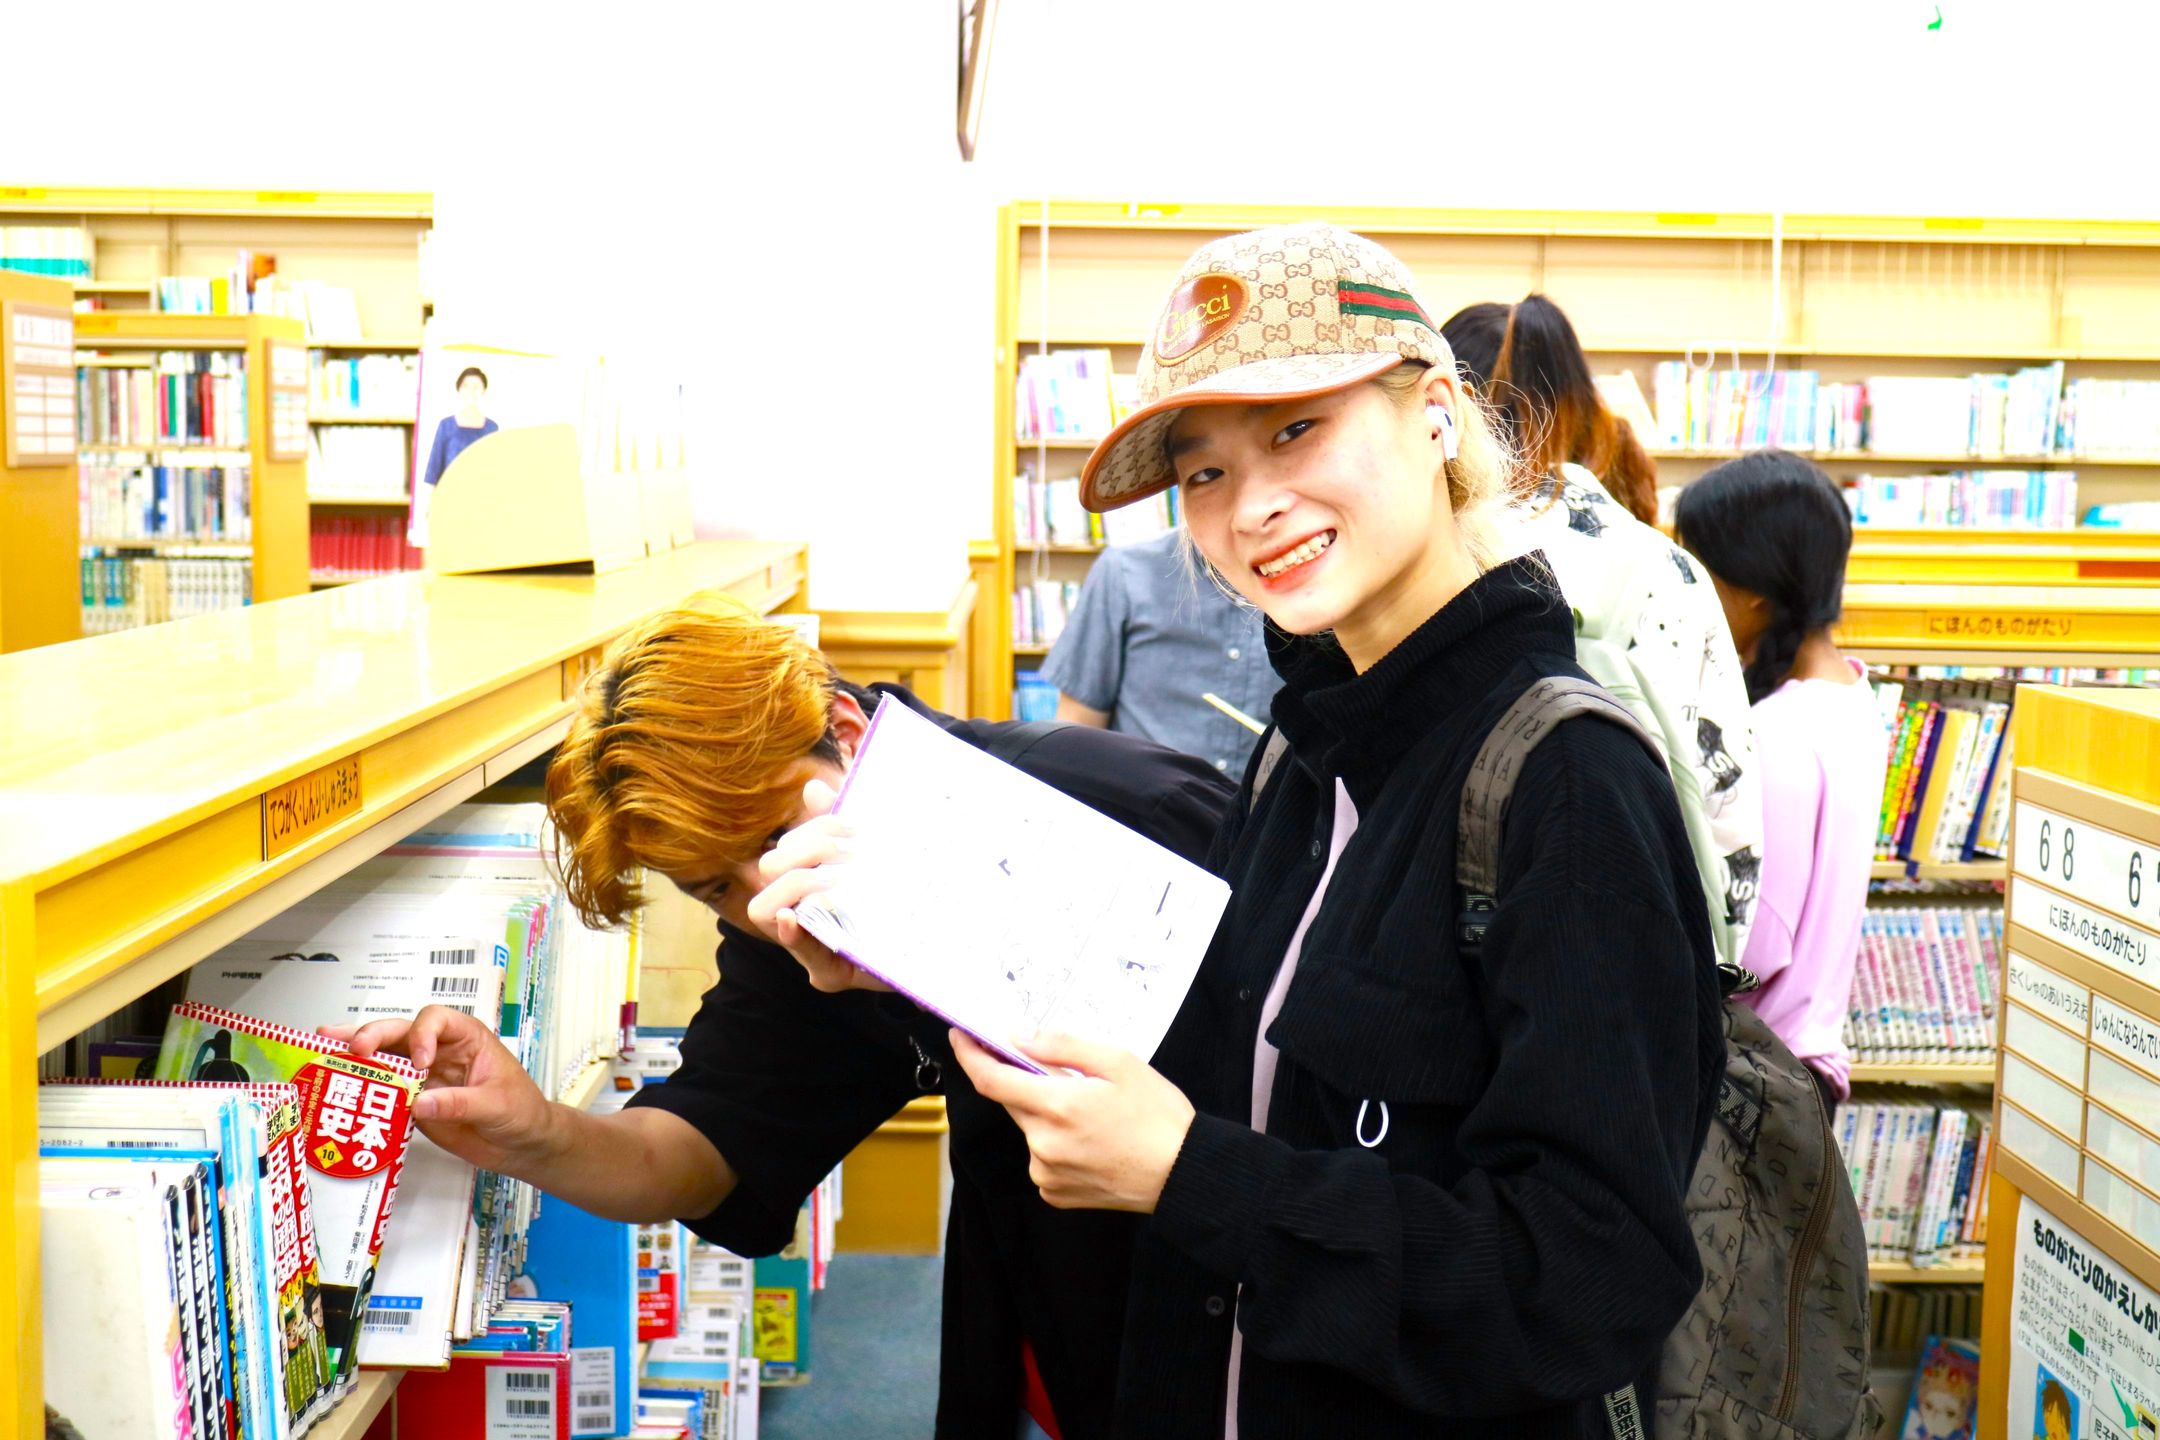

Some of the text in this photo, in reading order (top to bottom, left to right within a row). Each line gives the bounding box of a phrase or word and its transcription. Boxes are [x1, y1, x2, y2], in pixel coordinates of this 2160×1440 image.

[1163, 284, 1231, 342] Gucci
[1929, 616, 2073, 637] にほんのものがたり
[2049, 904, 2146, 966] にほんのものがたり
[350, 1064, 393, 1082] 学習まんが
[322, 1149, 335, 1161] 10
[2033, 1219, 2160, 1341] ものがたりのかえしか
